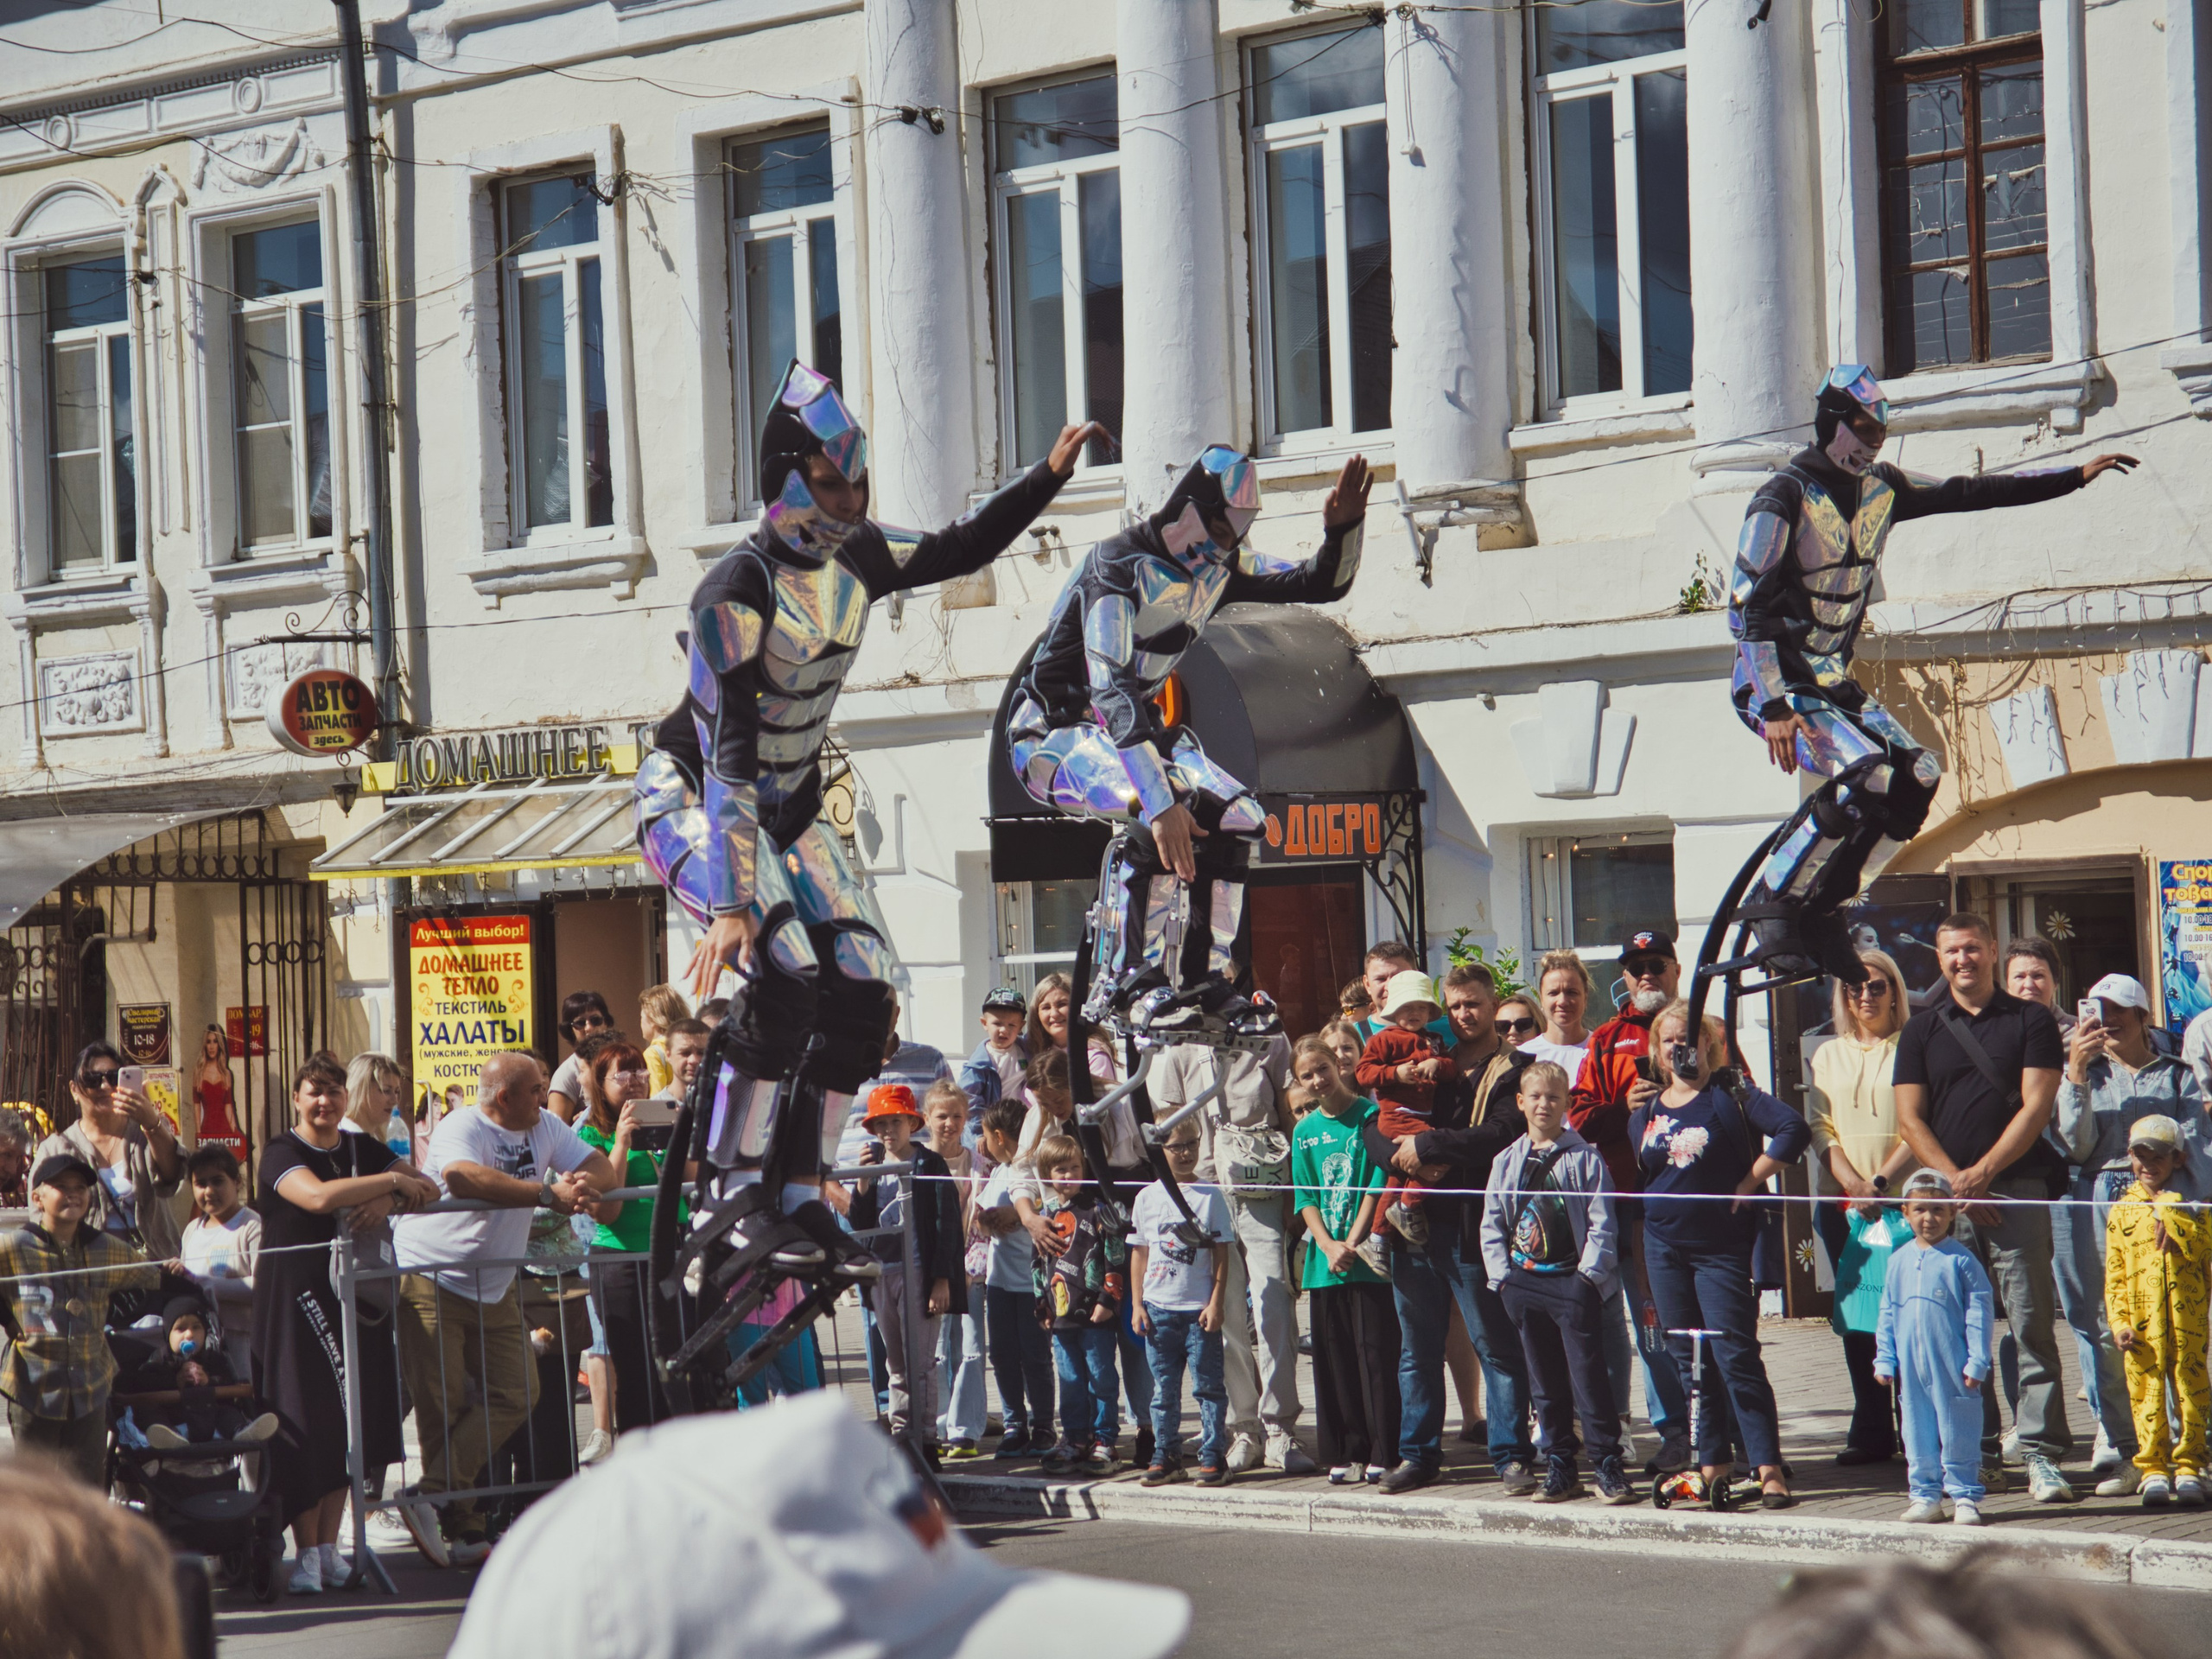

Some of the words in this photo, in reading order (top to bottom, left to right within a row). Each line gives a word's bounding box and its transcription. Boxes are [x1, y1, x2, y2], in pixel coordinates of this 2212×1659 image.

[296, 679, 359, 713] АВТО
[298, 713, 362, 731] ЗАПЧАСТИ
[394, 726, 613, 792] ДОМАШНЕЕ
[1284, 803, 1381, 855] ДОБРО
[416, 925, 470, 942] Лучший
[474, 924, 524, 939] выбор!
[417, 952, 524, 974] ДОМАШНЕЕ
[442, 975, 499, 995] ТЕПЛО
[435, 1000, 507, 1015] ТЕКСТИЛЬ
[418, 1019, 524, 1046] ХАЛАТЫ
[419, 1048, 473, 1060] (мужские,
[434, 1064, 481, 1077] КОСТЮ
[307, 1299, 328, 1331] STILL
[325, 1332, 342, 1364] HAVE
